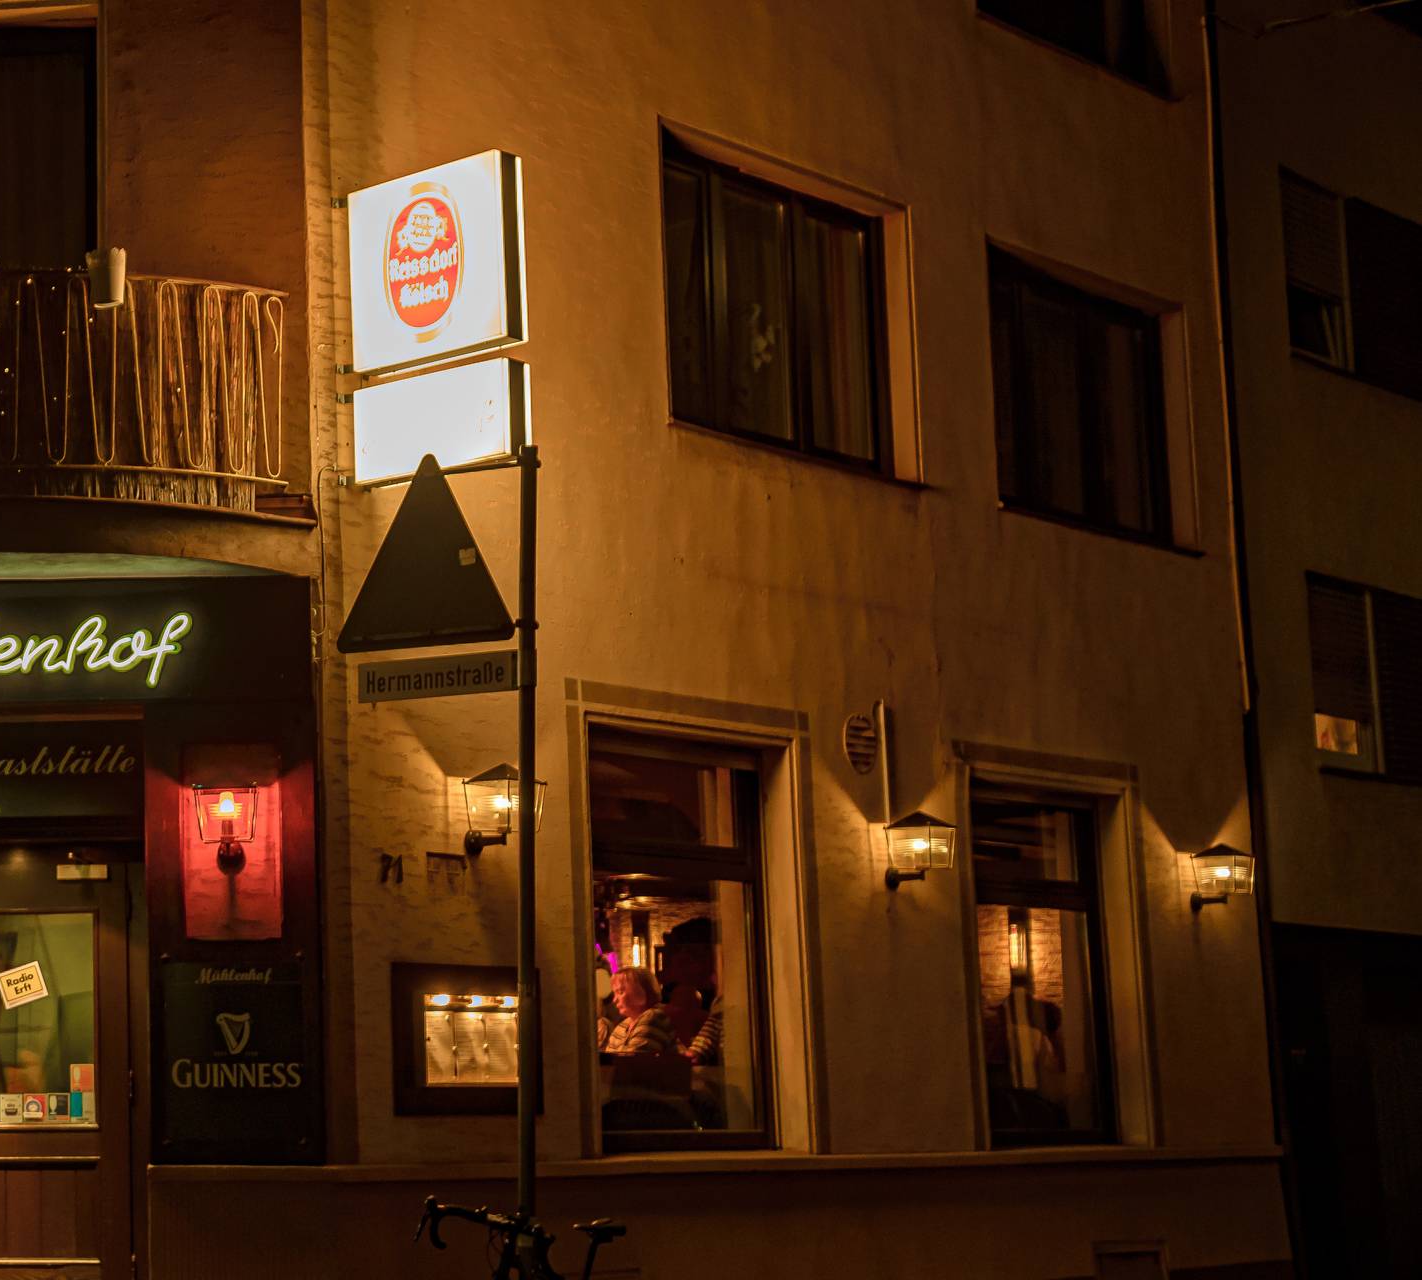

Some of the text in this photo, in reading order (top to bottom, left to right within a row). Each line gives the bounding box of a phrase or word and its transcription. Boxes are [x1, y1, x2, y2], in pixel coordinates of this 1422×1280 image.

[390, 241, 458, 282] Reissdorf
[366, 660, 506, 695] Hermannstraße
[5, 972, 34, 987] Radio
[194, 967, 273, 985] Mühlenhof
[14, 982, 32, 995] Erft
